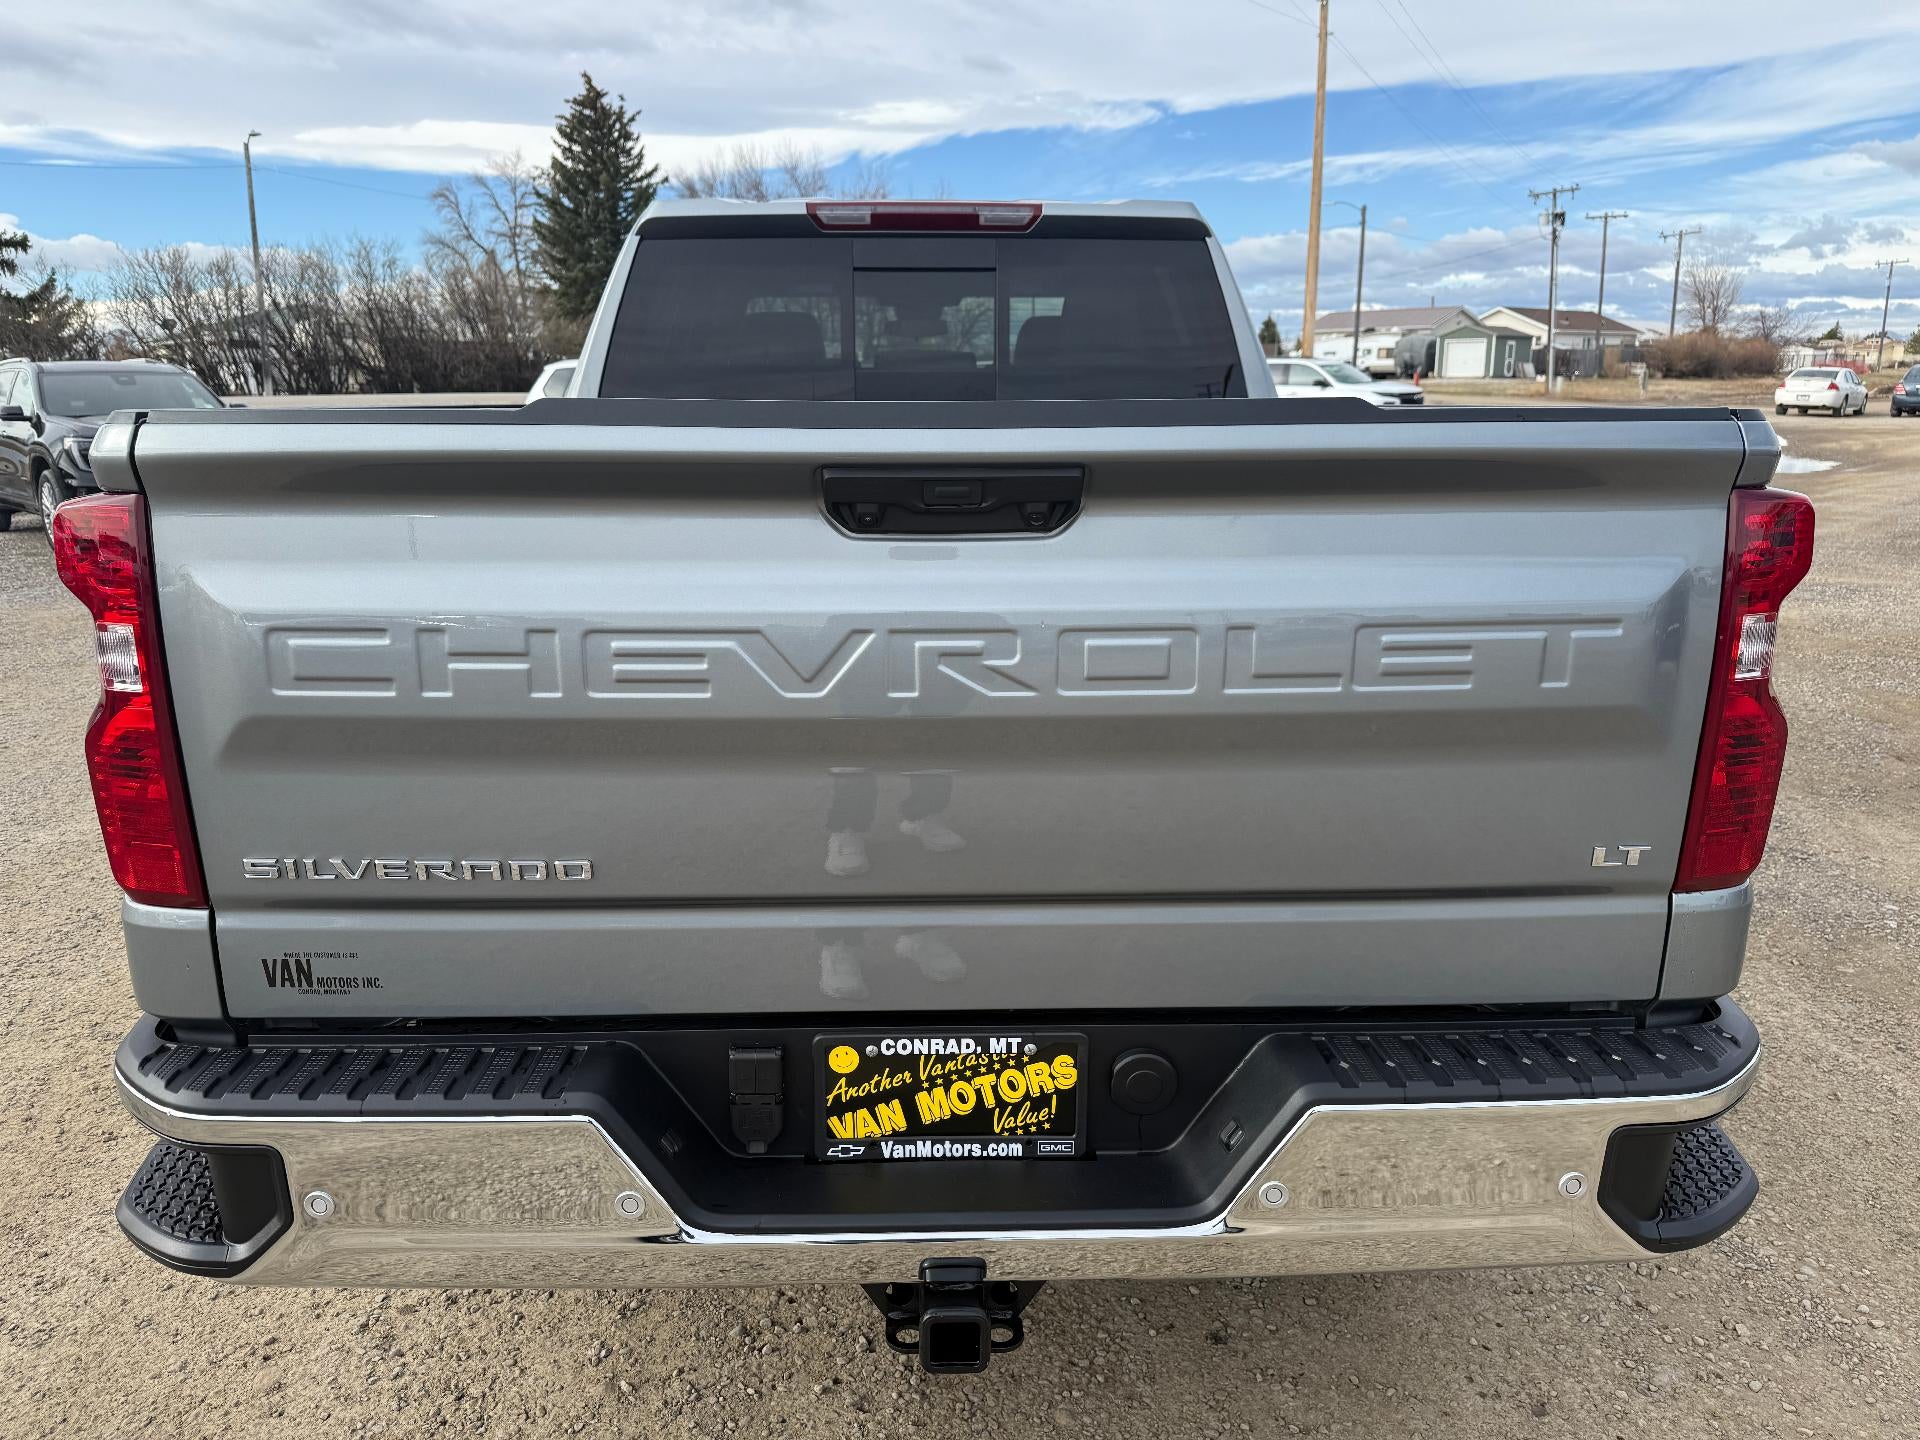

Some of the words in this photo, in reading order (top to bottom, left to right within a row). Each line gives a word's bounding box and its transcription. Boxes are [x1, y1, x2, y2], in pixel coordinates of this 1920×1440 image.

[264, 618, 1625, 699] CHEVROLET
[242, 857, 595, 882] SILVERADO
[1590, 844, 1652, 868] LT
[261, 959, 314, 988] VAN
[316, 976, 359, 989] MOTORS
[362, 976, 384, 989] INC.
[880, 1038, 982, 1055] CONRAD,
[989, 1037, 1022, 1054] MT
[826, 1067, 913, 1107] Another
[826, 1098, 907, 1139] VAN
[914, 1054, 1078, 1125] MOTORS
[993, 1094, 1057, 1134] Value!
[880, 1140, 1023, 1159] VanMotors.com
[1040, 1143, 1073, 1152] GMC
